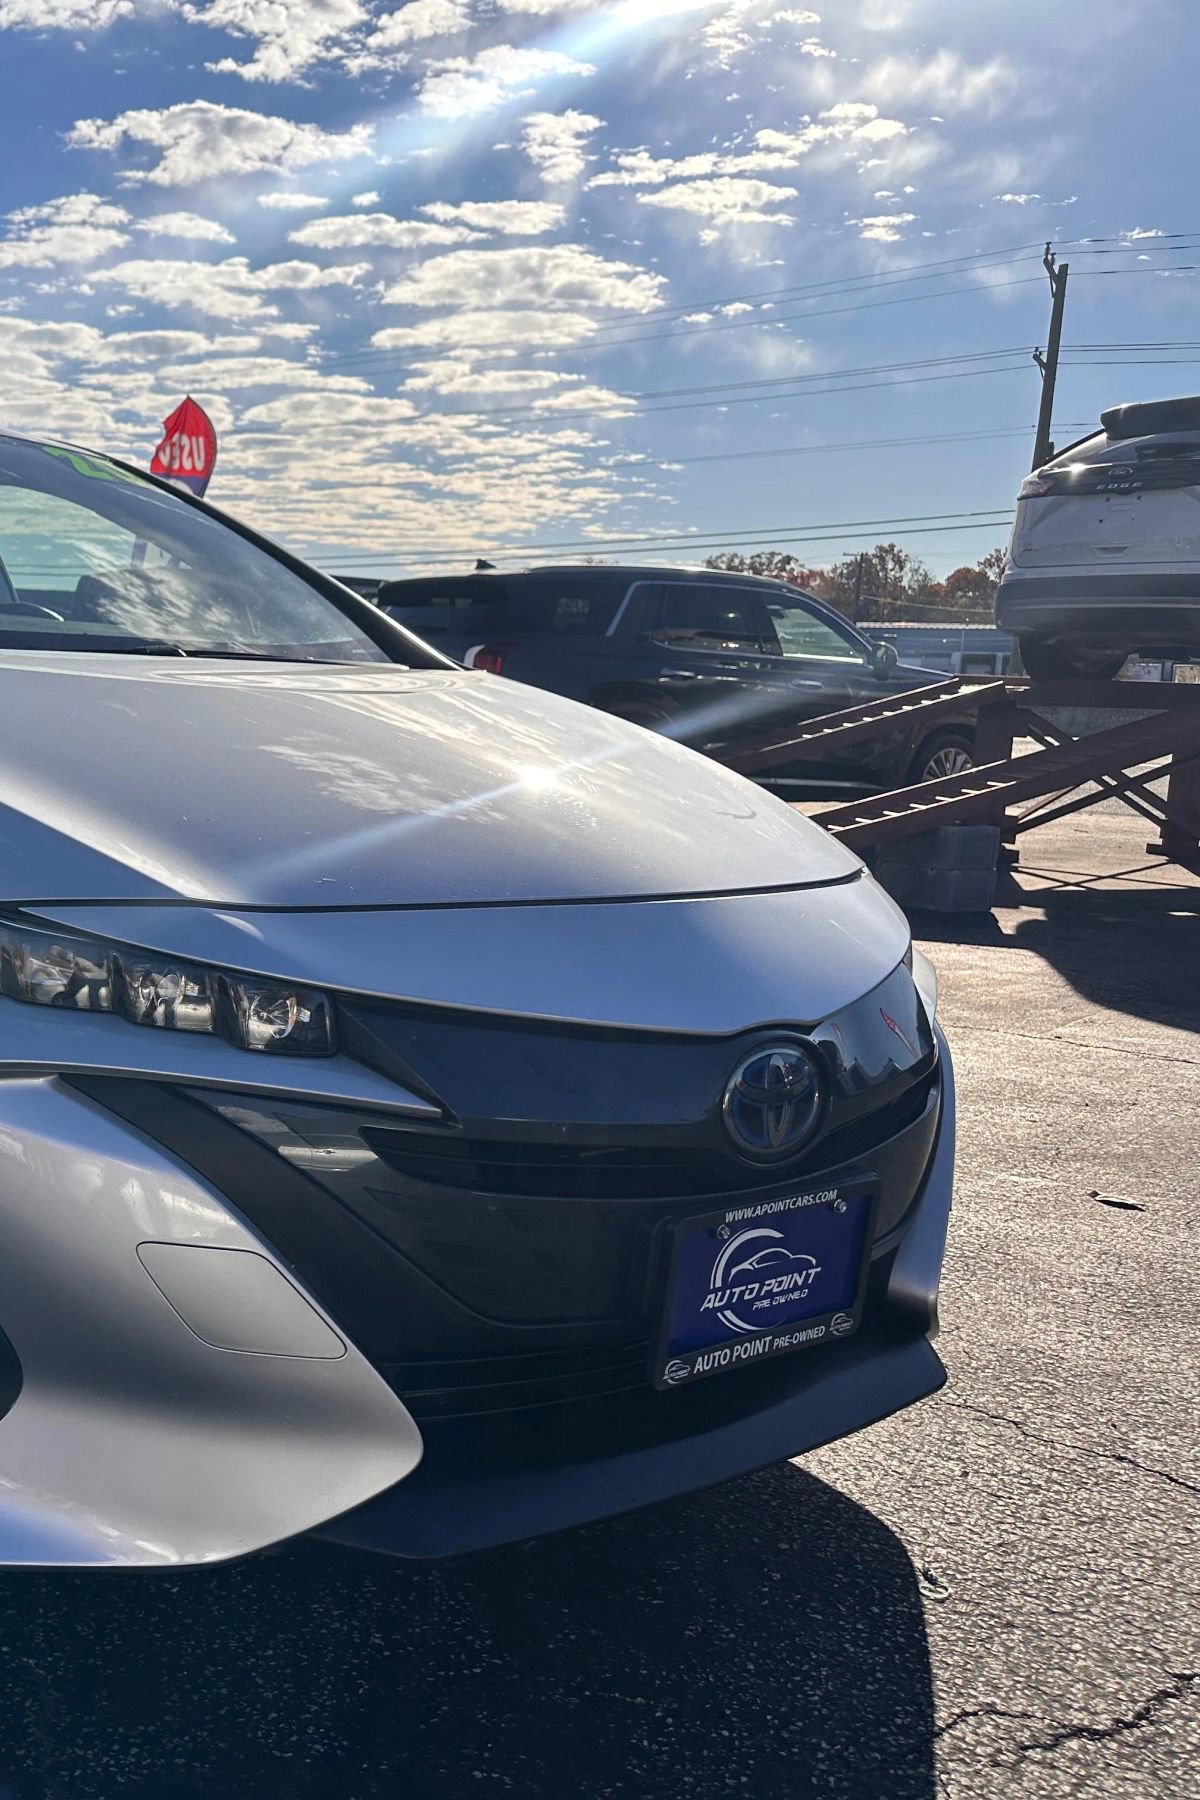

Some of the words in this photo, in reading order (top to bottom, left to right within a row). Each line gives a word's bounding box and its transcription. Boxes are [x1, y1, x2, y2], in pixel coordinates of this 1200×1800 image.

[725, 1189, 838, 1223] WWW.APOINTCARS.COM
[700, 1283, 760, 1311] AUTO
[760, 1267, 821, 1296] POINT
[752, 1299, 771, 1311] PRE
[772, 1289, 808, 1305] OWNED
[693, 1354, 730, 1374] AUTO
[732, 1336, 773, 1362] POINT
[773, 1325, 826, 1350] PRE-OWNED
